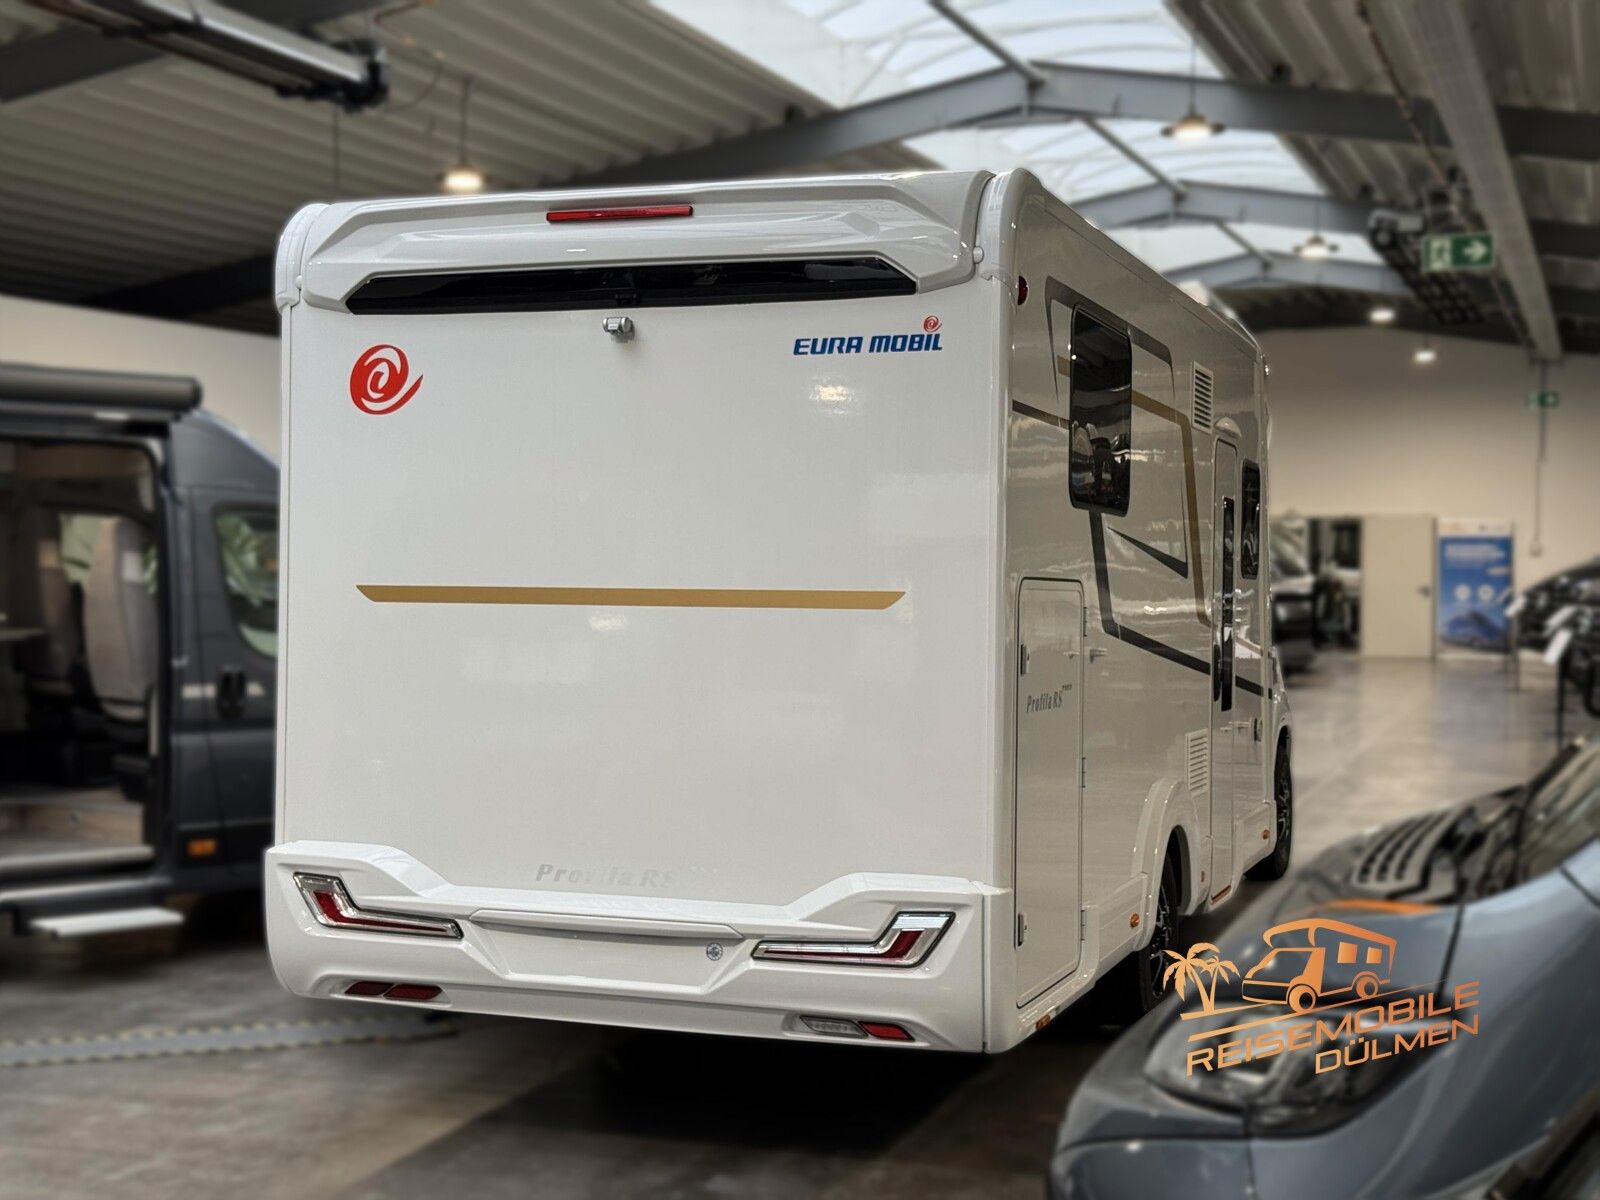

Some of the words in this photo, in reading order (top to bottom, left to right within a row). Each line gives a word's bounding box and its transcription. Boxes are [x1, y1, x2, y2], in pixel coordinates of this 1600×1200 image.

[793, 337, 863, 355] EURA
[869, 334, 942, 353] MOBIL
[1027, 694, 1052, 713] Profila
